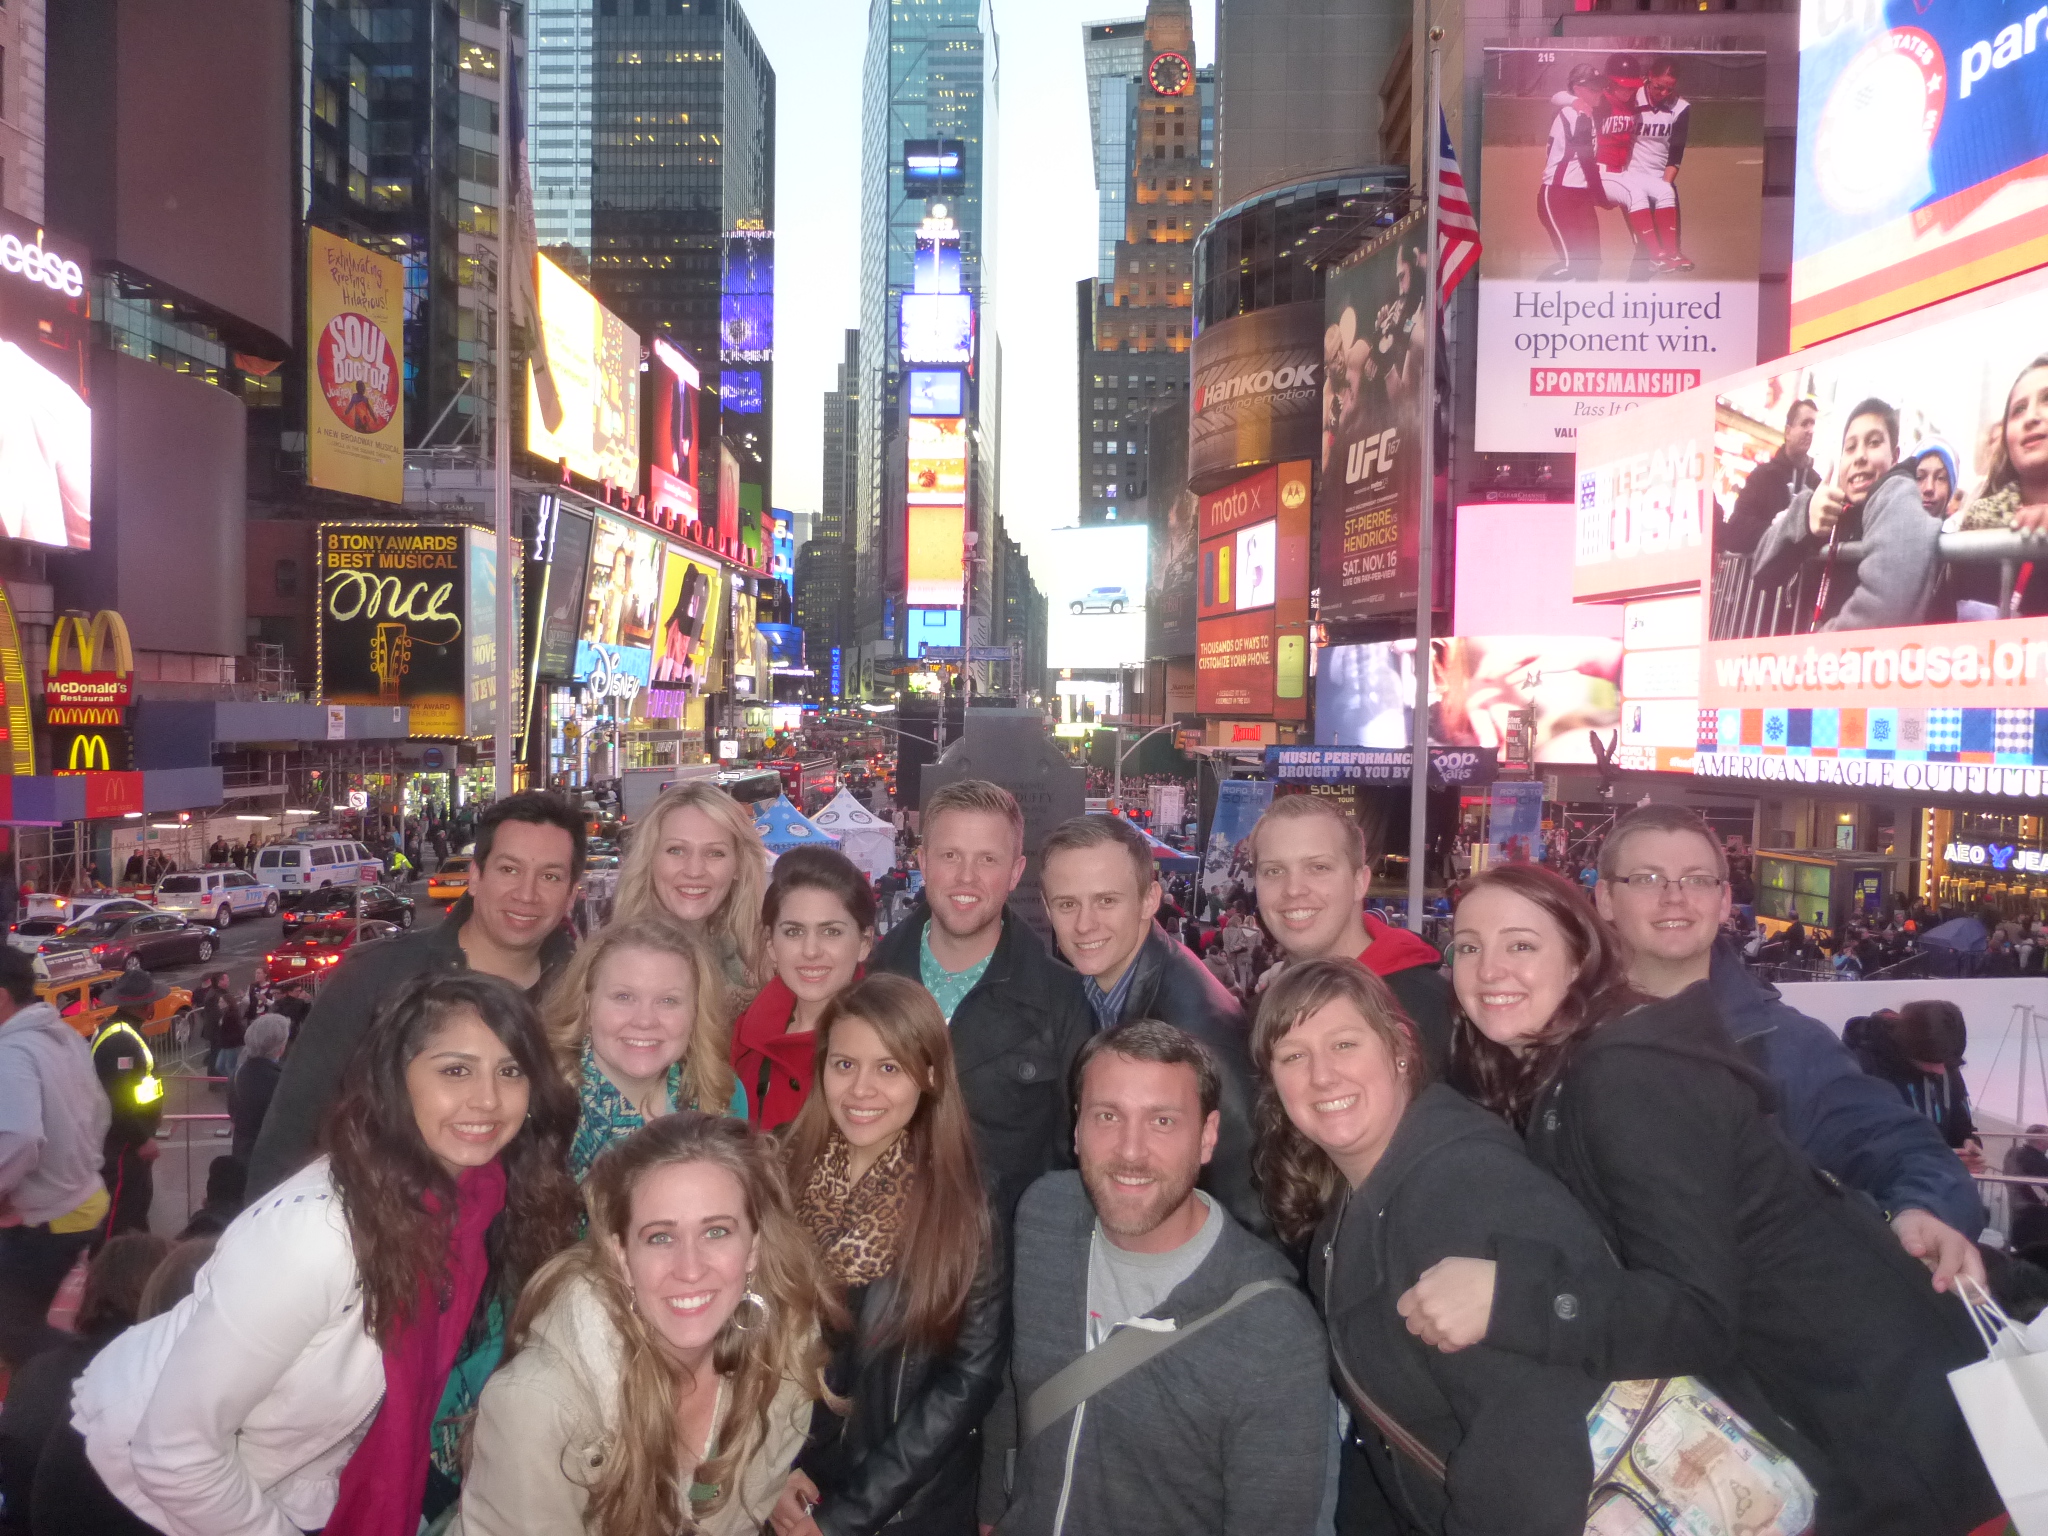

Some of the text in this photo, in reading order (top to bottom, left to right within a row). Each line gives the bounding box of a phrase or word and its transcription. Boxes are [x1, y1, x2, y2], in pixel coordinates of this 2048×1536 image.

[1538, 53, 1555, 62] 215
[1959, 6, 2048, 99] par
[1637, 122, 1673, 137] ENTRA
[1353, 204, 1427, 263] ANNIVERSARY
[0, 233, 84, 297] eese
[1513, 290, 1722, 327] Helped injured
[329, 315, 386, 367] SOUL
[1514, 325, 1718, 359] opponent win.
[333, 357, 390, 394] DOCTOR
[1535, 371, 1696, 395] SPORTSMANSHIP
[1215, 389, 1316, 414] driving emotion
[1573, 401, 1605, 417] Pass
[317, 426, 401, 455] A NEW BROADWAY MUSICAL
[1346, 427, 1400, 484] UFC 167
[1212, 487, 1248, 527] moto
[601, 479, 660, 525] 1540
[665, 507, 757, 567] BROADWAY
[1344, 508, 1391, 536] ST-PIERRE
[328, 534, 457, 550] 8 TONY AWARDS
[1343, 525, 1397, 553] HENDRICKS
[328, 553, 457, 569] BEST MUSICAL
[1342, 550, 1397, 577] SAT. NOV. 16
[1353, 575, 1361, 585] ON
[1361, 568, 1397, 583] PAY-PER-VIEW
[1201, 635, 1269, 655] THOUSANDS OF WAYS TO
[1199, 651, 1271, 670] CUSTOMIZE YOUR PHONE.
[1713, 640, 2048, 688] www.teamusa.or
[47, 682, 127, 693] McDonald's
[60, 694, 114, 702] Restaurant
[424, 703, 451, 711] AWARD
[646, 689, 685, 719] FOREVER
[1507, 723, 1522, 731] WALLS
[1279, 752, 1321, 764] MUSIC
[1323, 752, 1412, 765] PERFORMANC
[1697, 755, 1807, 782] AMERICAN
[1818, 759, 1895, 787] EAGLE
[1278, 766, 1340, 778] BROUGHT
[1343, 766, 1361, 778] TO
[1364, 767, 1389, 778] YOU
[1392, 767, 1410, 778] BY
[1944, 843, 1986, 864] AEO
